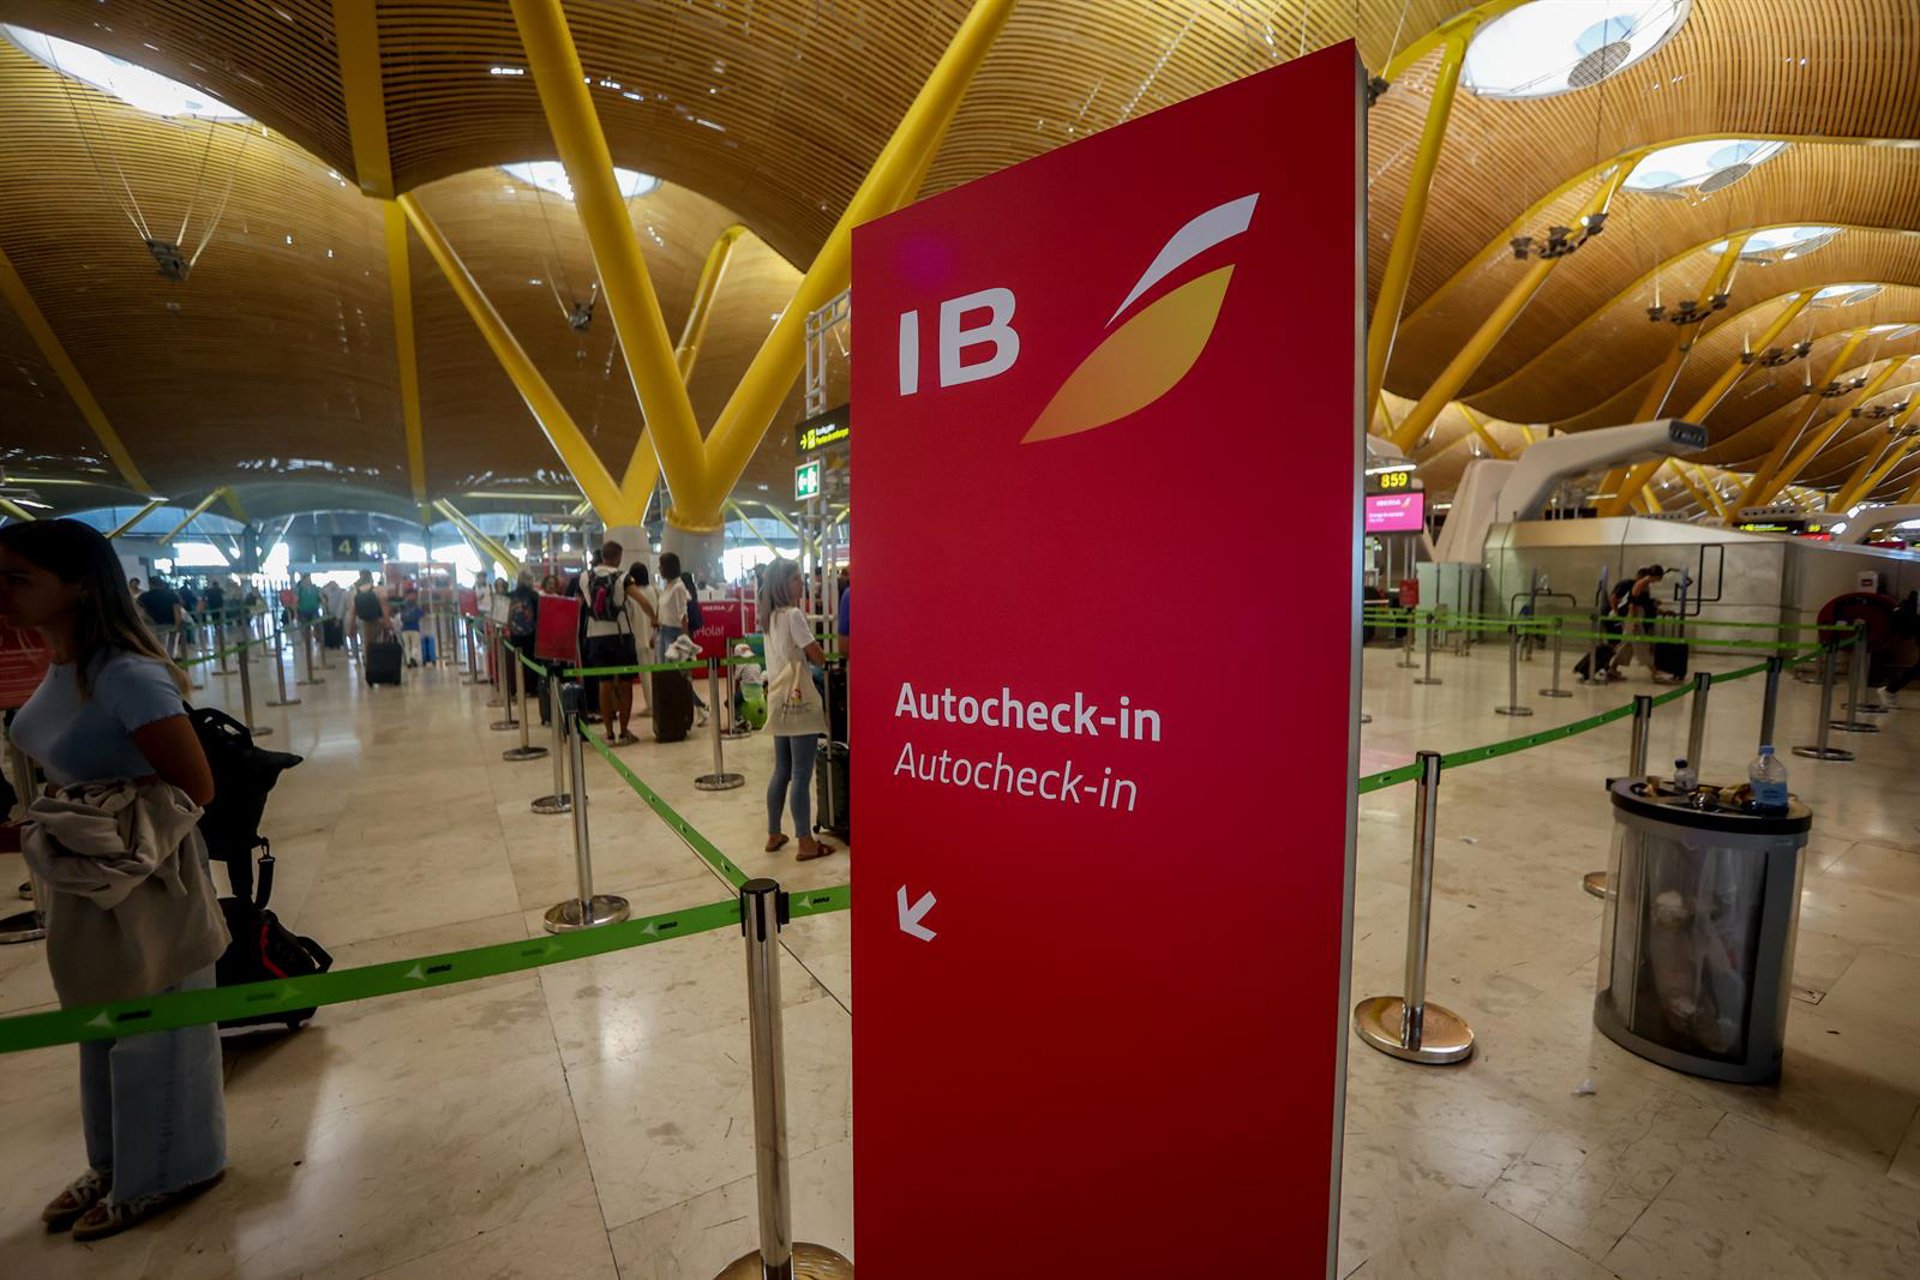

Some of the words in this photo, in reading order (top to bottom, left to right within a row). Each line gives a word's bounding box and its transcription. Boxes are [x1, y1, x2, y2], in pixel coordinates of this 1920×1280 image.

[899, 287, 1020, 397] IB
[1381, 472, 1408, 488] 859
[339, 539, 352, 555] 4
[895, 682, 1161, 742] Autocheck-in
[893, 742, 1138, 812] Autocheck-in
